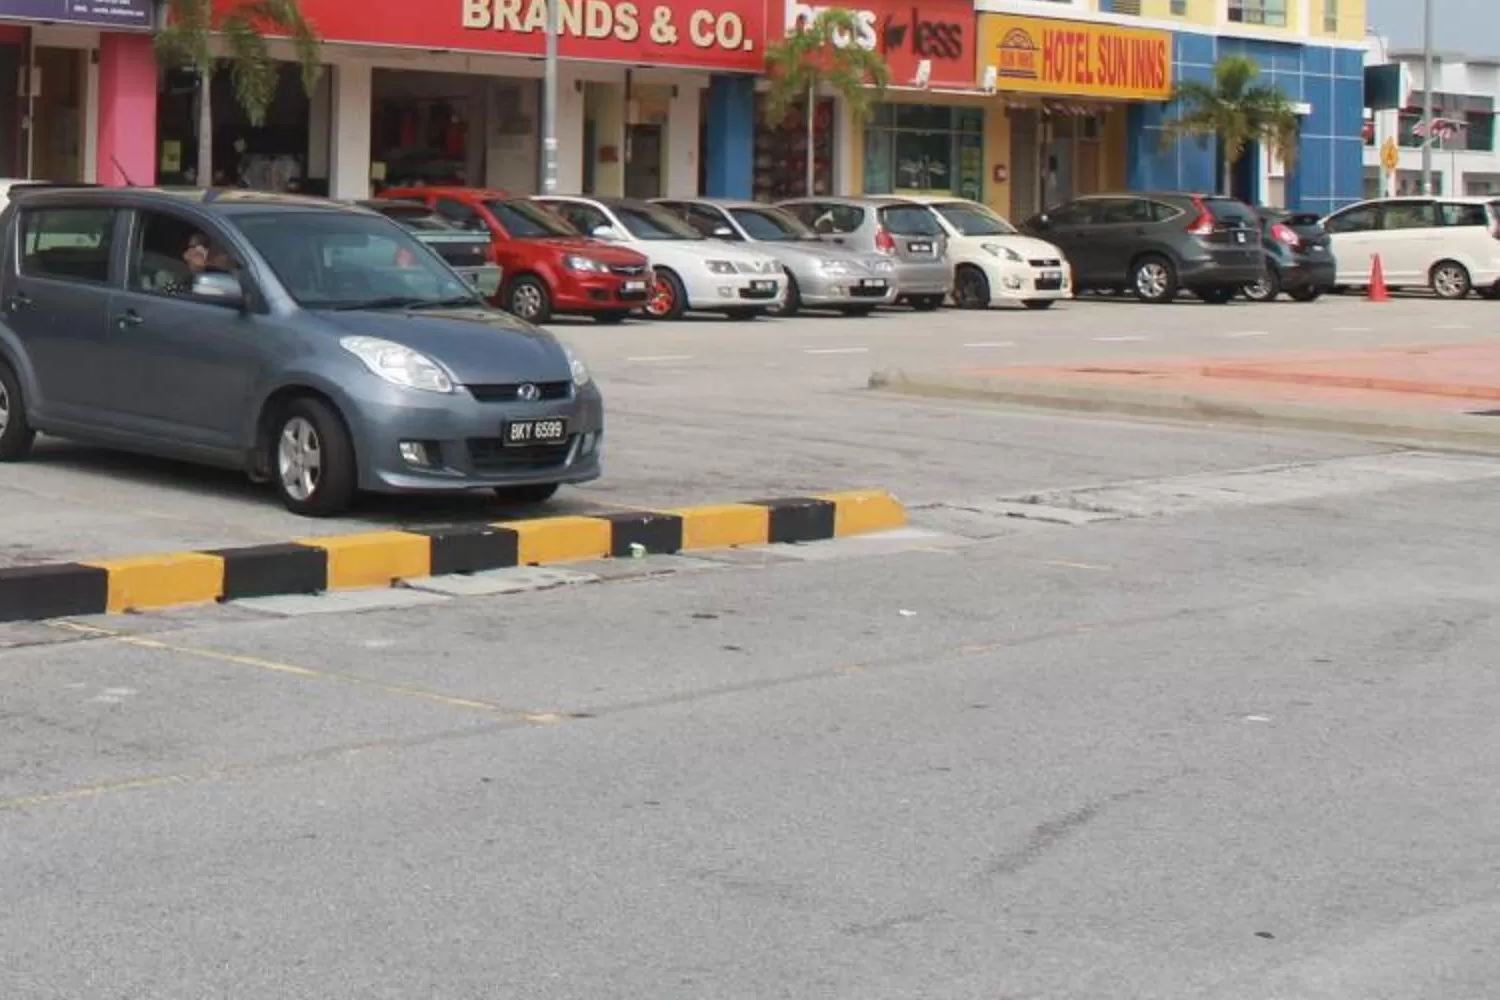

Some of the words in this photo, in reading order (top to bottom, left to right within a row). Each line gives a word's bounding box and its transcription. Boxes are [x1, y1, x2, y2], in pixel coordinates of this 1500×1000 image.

[649, 5, 677, 44] &
[689, 8, 753, 51] CO.
[911, 7, 963, 61] less
[1041, 29, 1093, 85] HOTEL
[1097, 34, 1128, 88] SUN
[1130, 38, 1166, 89] INNS
[511, 423, 532, 441] BKY
[535, 421, 563, 439] 6599
